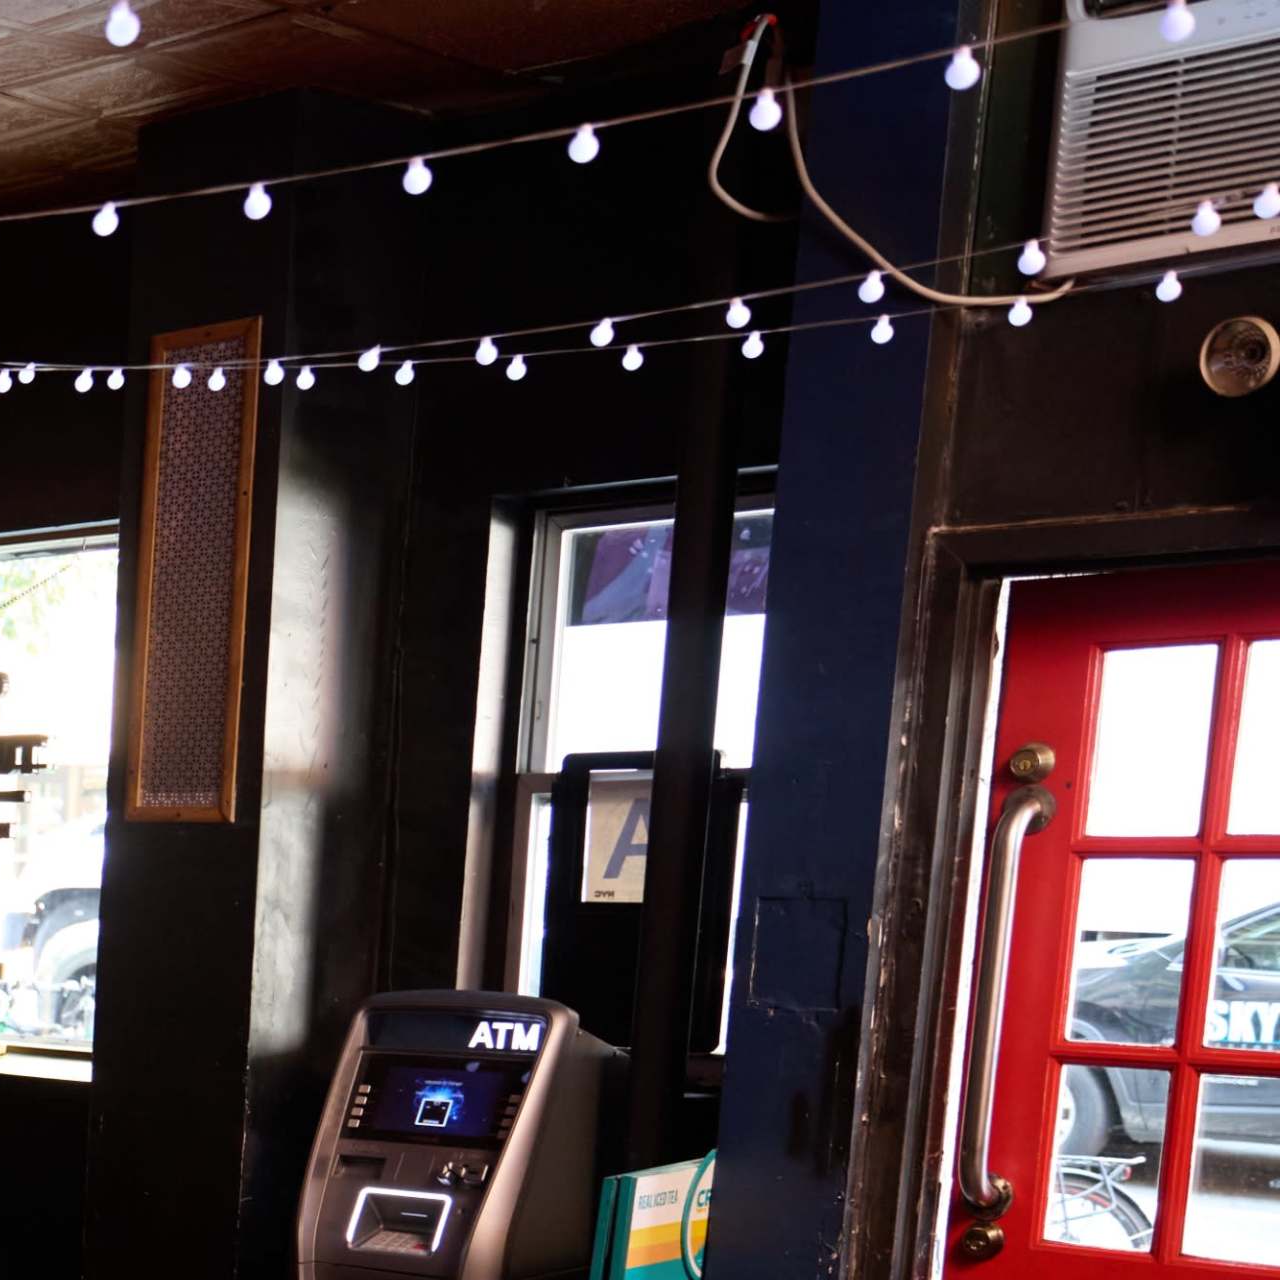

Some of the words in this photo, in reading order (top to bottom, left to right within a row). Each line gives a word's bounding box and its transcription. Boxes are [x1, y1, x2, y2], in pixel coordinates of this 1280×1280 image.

[603, 798, 652, 879] A
[467, 1020, 541, 1051] ATM
[1206, 999, 1280, 1044] SKY
